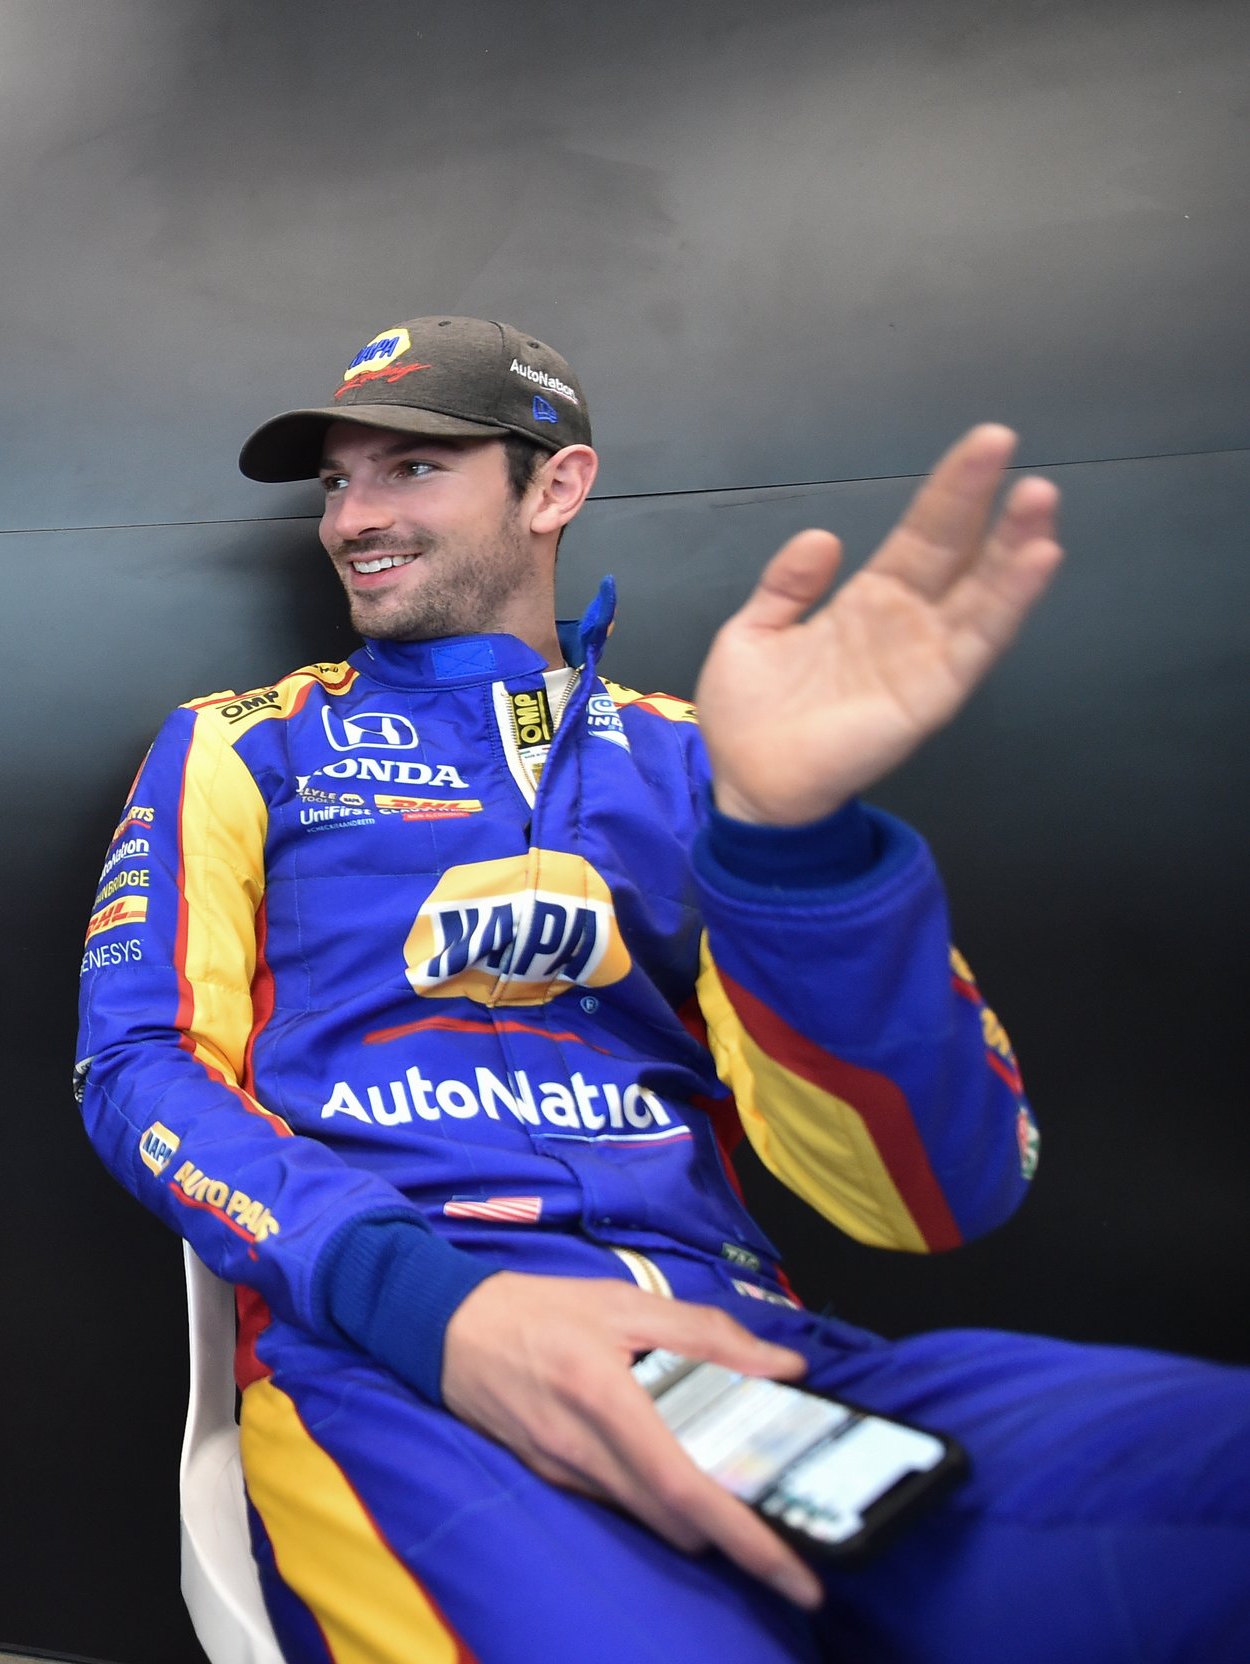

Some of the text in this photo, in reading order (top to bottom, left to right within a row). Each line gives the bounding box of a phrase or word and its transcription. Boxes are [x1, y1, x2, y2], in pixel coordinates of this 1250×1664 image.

[510, 358, 578, 401] AutoNation
[221, 690, 280, 718] OMP
[514, 693, 543, 744] OMP
[300, 806, 372, 825] UniFirst
[428, 900, 598, 980] NAPA
